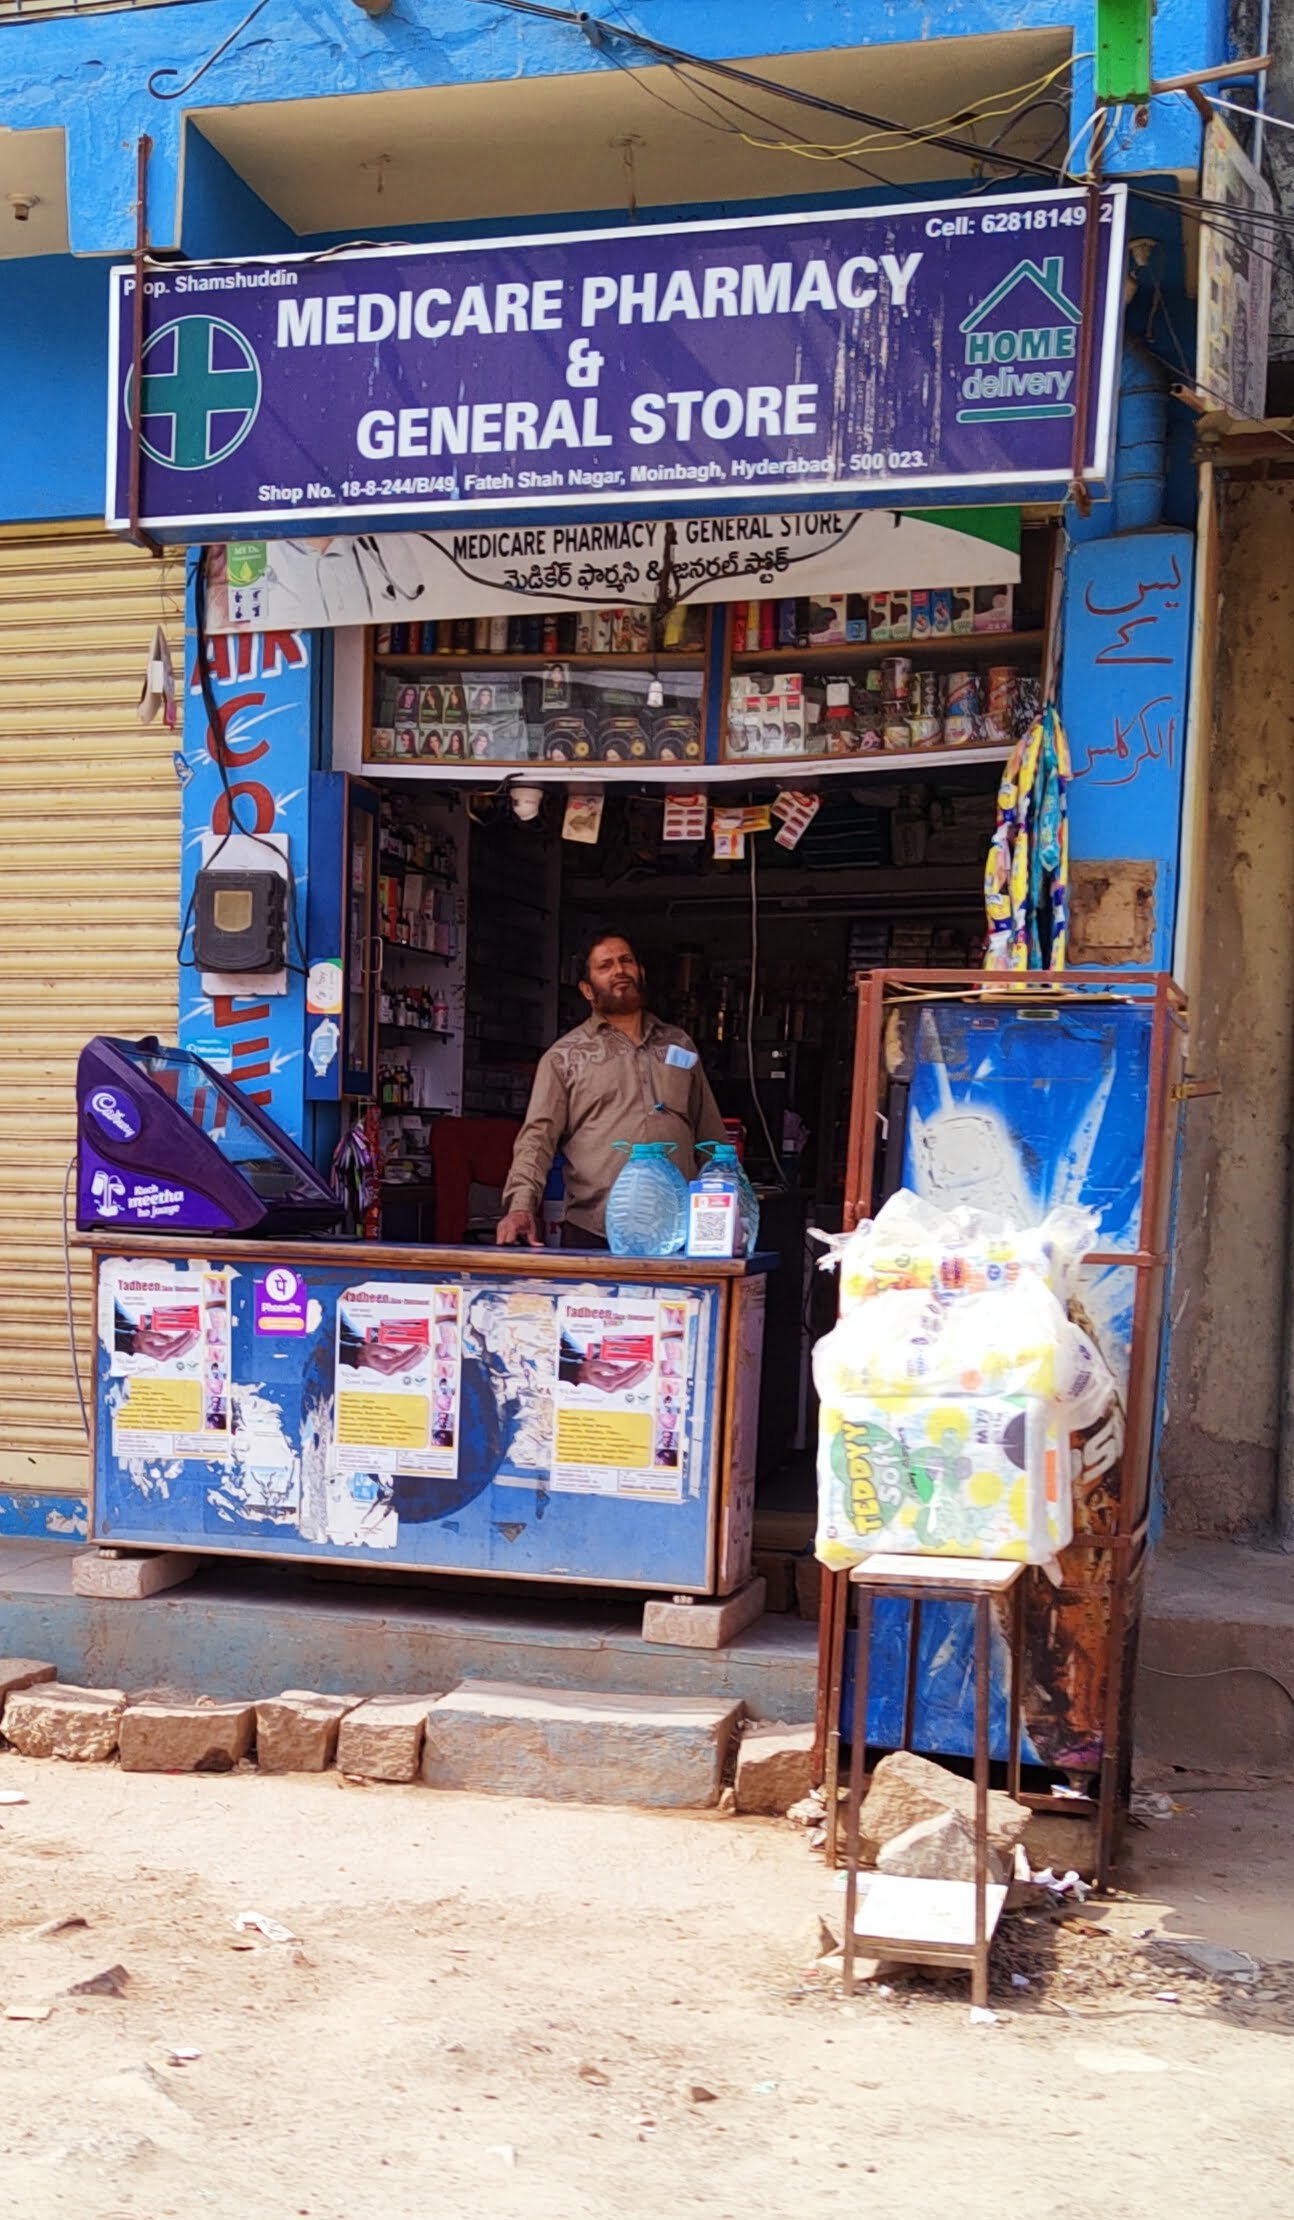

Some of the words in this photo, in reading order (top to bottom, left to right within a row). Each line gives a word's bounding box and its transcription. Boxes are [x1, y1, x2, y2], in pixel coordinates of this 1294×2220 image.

[925, 216, 976, 238] Cell:
[980, 203, 1113, 234] 628181492
[123, 276, 171, 298] Pop.
[174, 270, 299, 293] Shamshuddin
[276, 280, 565, 348] MEDICARE
[580, 252, 924, 328] PHARMACY
[565, 338, 605, 389] &
[965, 326, 1077, 364] HOME
[961, 367, 1074, 401] delivery
[356, 397, 613, 460] GENERAL
[629, 384, 819, 445] STORE
[258, 485, 304, 504] Shop
[307, 483, 336, 500] No.
[464, 472, 514, 491] Fateh
[517, 470, 564, 489] Shah
[567, 468, 626, 490] Nagar,
[630, 460, 727, 483] Moinbagh,
[731, 455, 833, 479] Hyderabad
[849, 453, 886, 471] 500
[453, 531, 546, 560] MEDICARE
[552, 522, 657, 555] PHARMACY
[685, 518, 773, 545] GENERAL
[781, 513, 843, 537] STORE
[645, 560, 661, 582] &
[127, 1189, 185, 1209] meetha
[840, 1420, 885, 1537] TEDDYY
